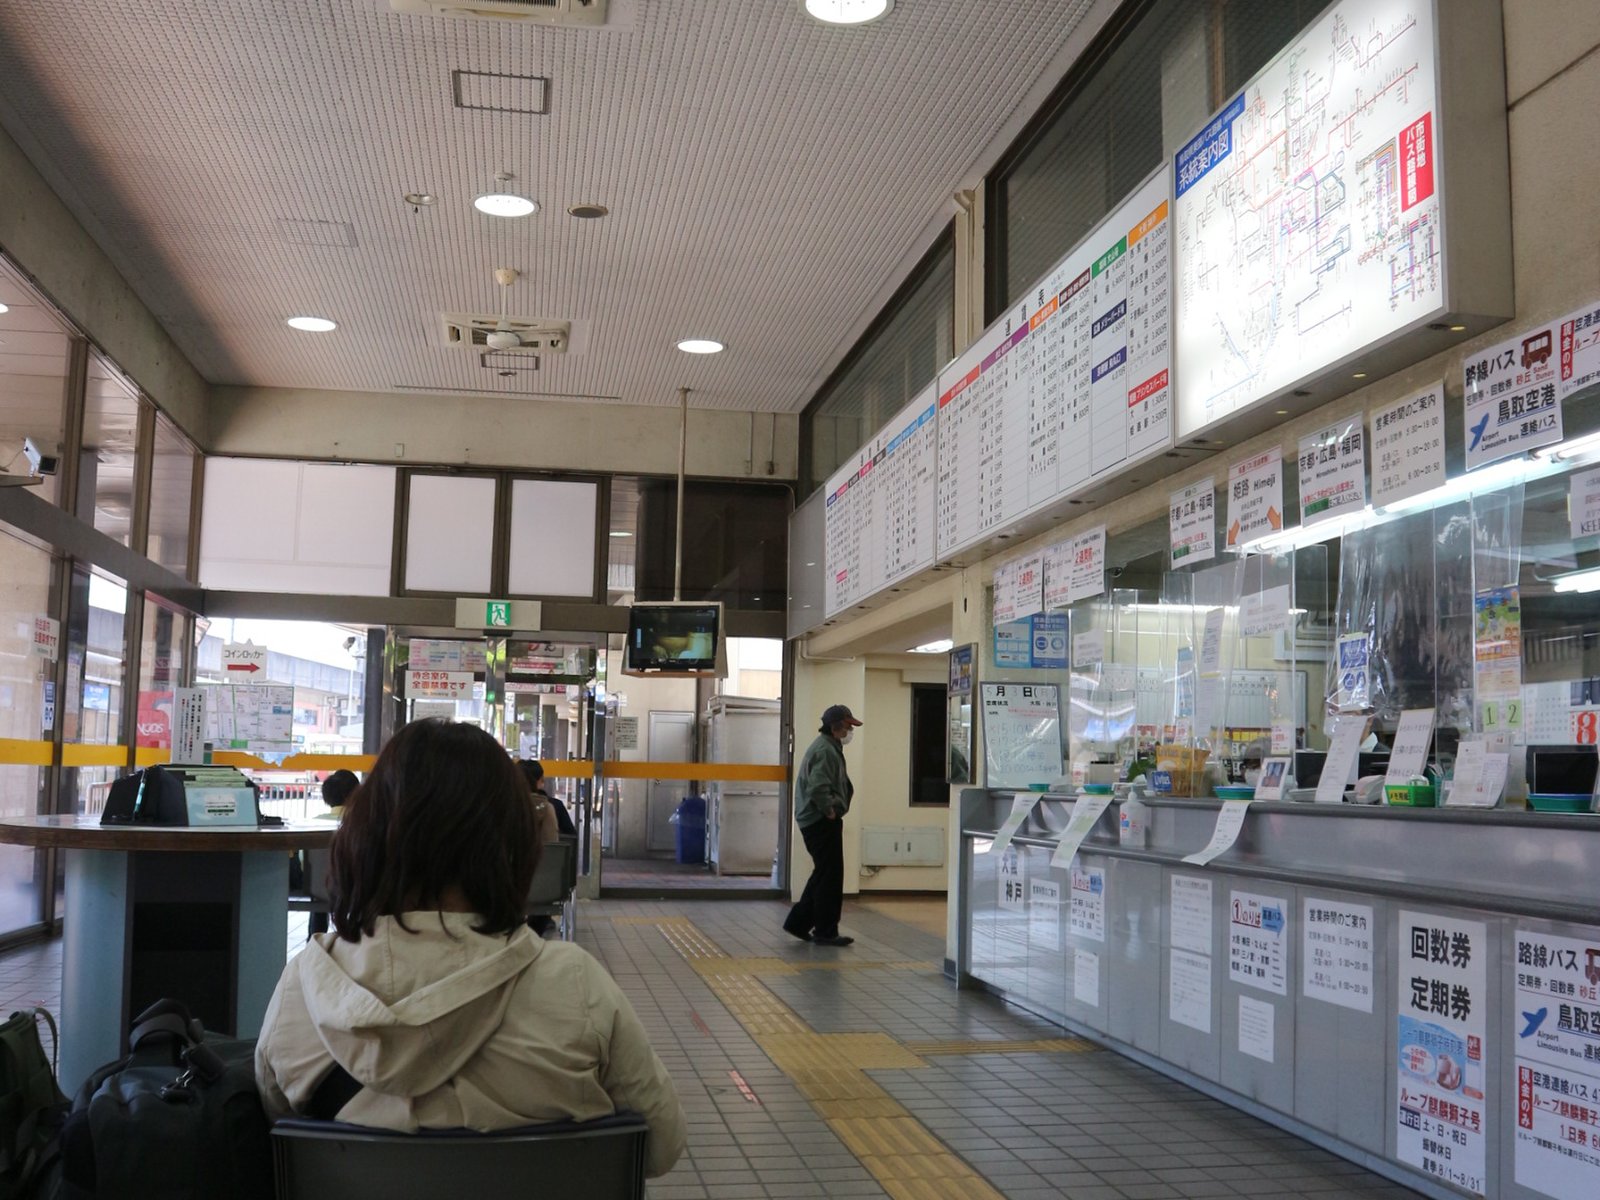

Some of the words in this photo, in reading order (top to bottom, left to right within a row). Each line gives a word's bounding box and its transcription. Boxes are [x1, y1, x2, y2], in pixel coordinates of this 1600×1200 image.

[1415, 120, 1426, 168] 市街地
[1179, 128, 1228, 191] 系統案内図
[1465, 349, 1516, 388] 路線バス
[1497, 383, 1556, 423] 鳥取空港
[1520, 414, 1557, 437] 連絡バス
[224, 649, 264, 659] コインロッカー
[412, 671, 449, 680] 待合室内
[412, 681, 467, 690] 全面禁煙です
[996, 685, 1006, 697] 月
[1023, 686, 1033, 698] 日
[1508, 704, 1519, 724] 2
[1006, 880, 1022, 902] 神戸
[1309, 908, 1367, 931] 営業時間のご案内
[1411, 926, 1471, 969] 回数券
[1518, 941, 1579, 972] 路線バス
[1410, 976, 1471, 1022] 定期券
[1579, 985, 1597, 1001] 砂丘
[1537, 1030, 1559, 1042] Airport
[1537, 1039, 1568, 1056] Limousine
[1570, 1048, 1582, 1058] Bus
[1533, 1071, 1588, 1099] 空港連絡バス
[1520, 1067, 1531, 1128] 現金のみ
[1422, 1138, 1452, 1160] 振替休日
